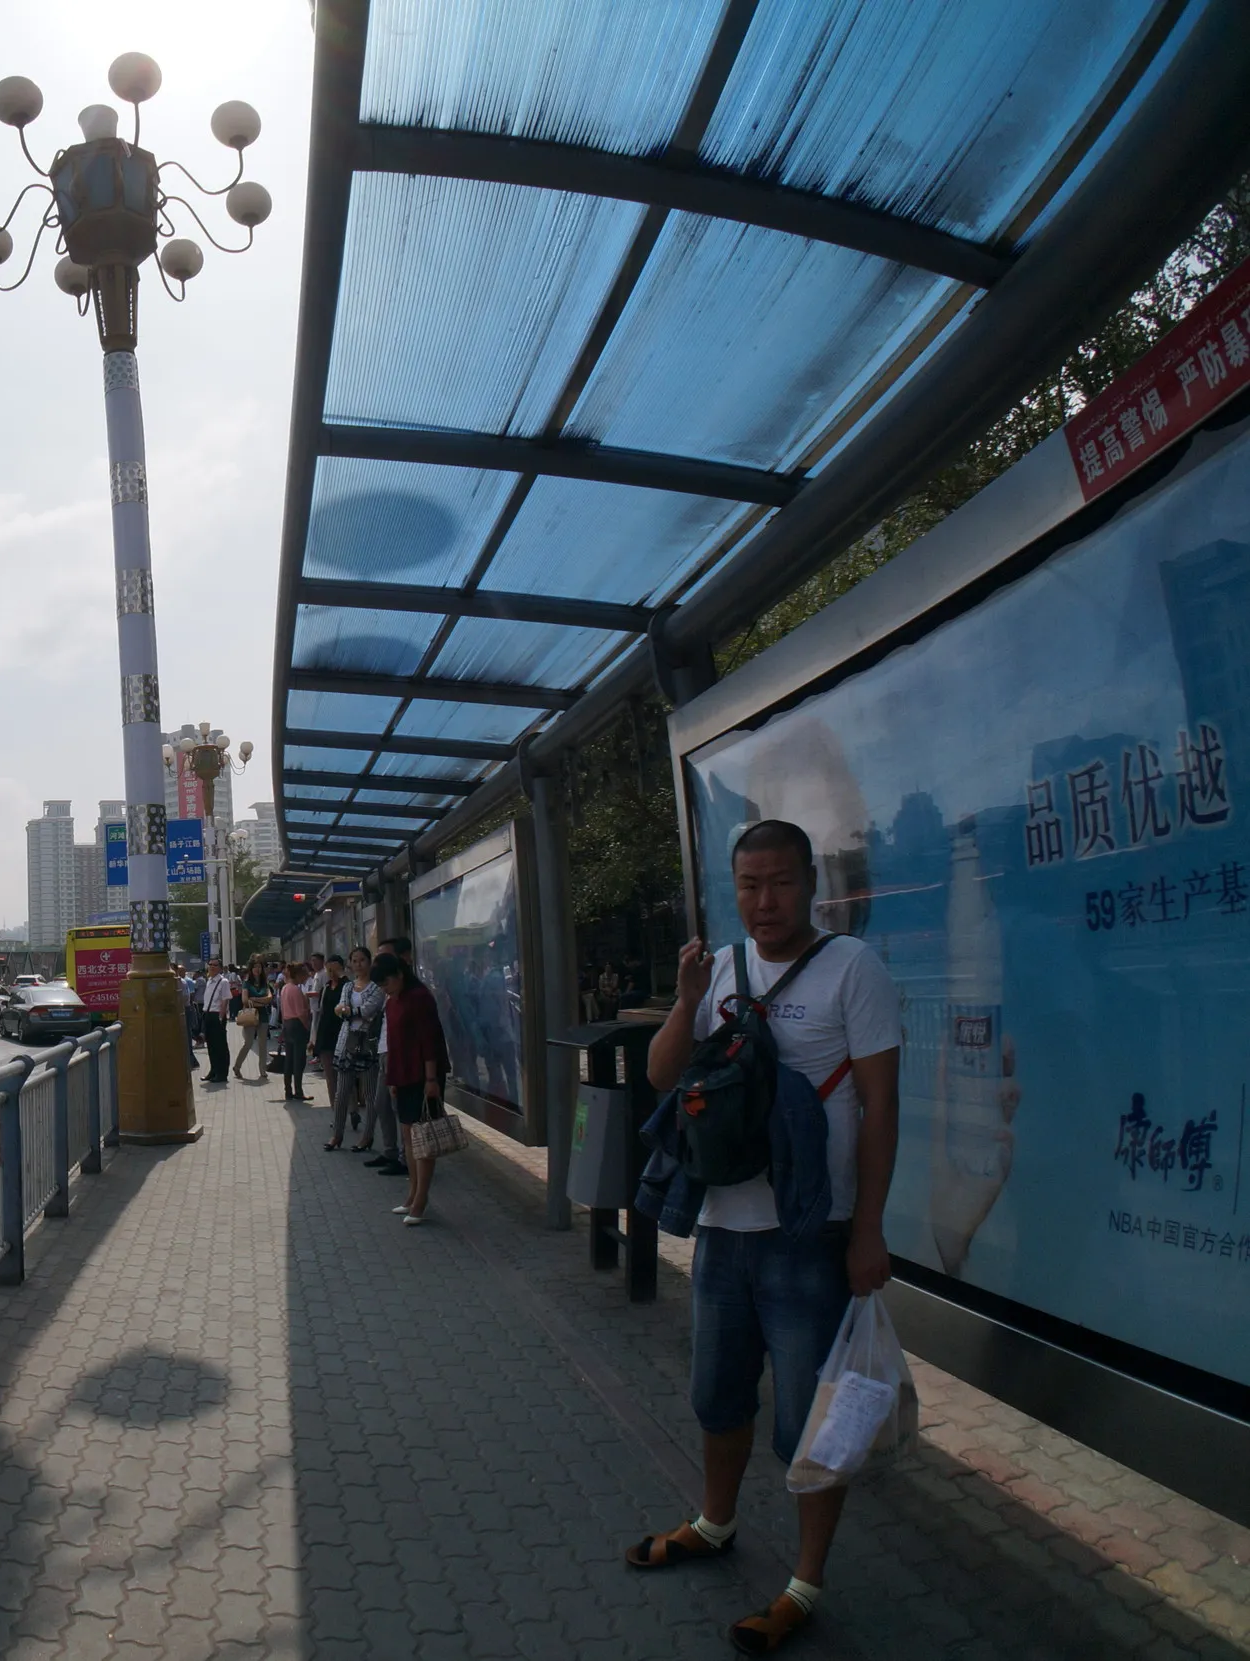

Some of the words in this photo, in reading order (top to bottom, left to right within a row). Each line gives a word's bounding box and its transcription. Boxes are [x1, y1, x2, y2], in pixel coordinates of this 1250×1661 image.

[1079, 388, 1169, 485] 提高警惕
[1025, 724, 1230, 866] 品质优越
[108, 859, 129, 868] 新华
[1086, 860, 1250, 931] 59家生产基
[1108, 1209, 1144, 1239] NBA
